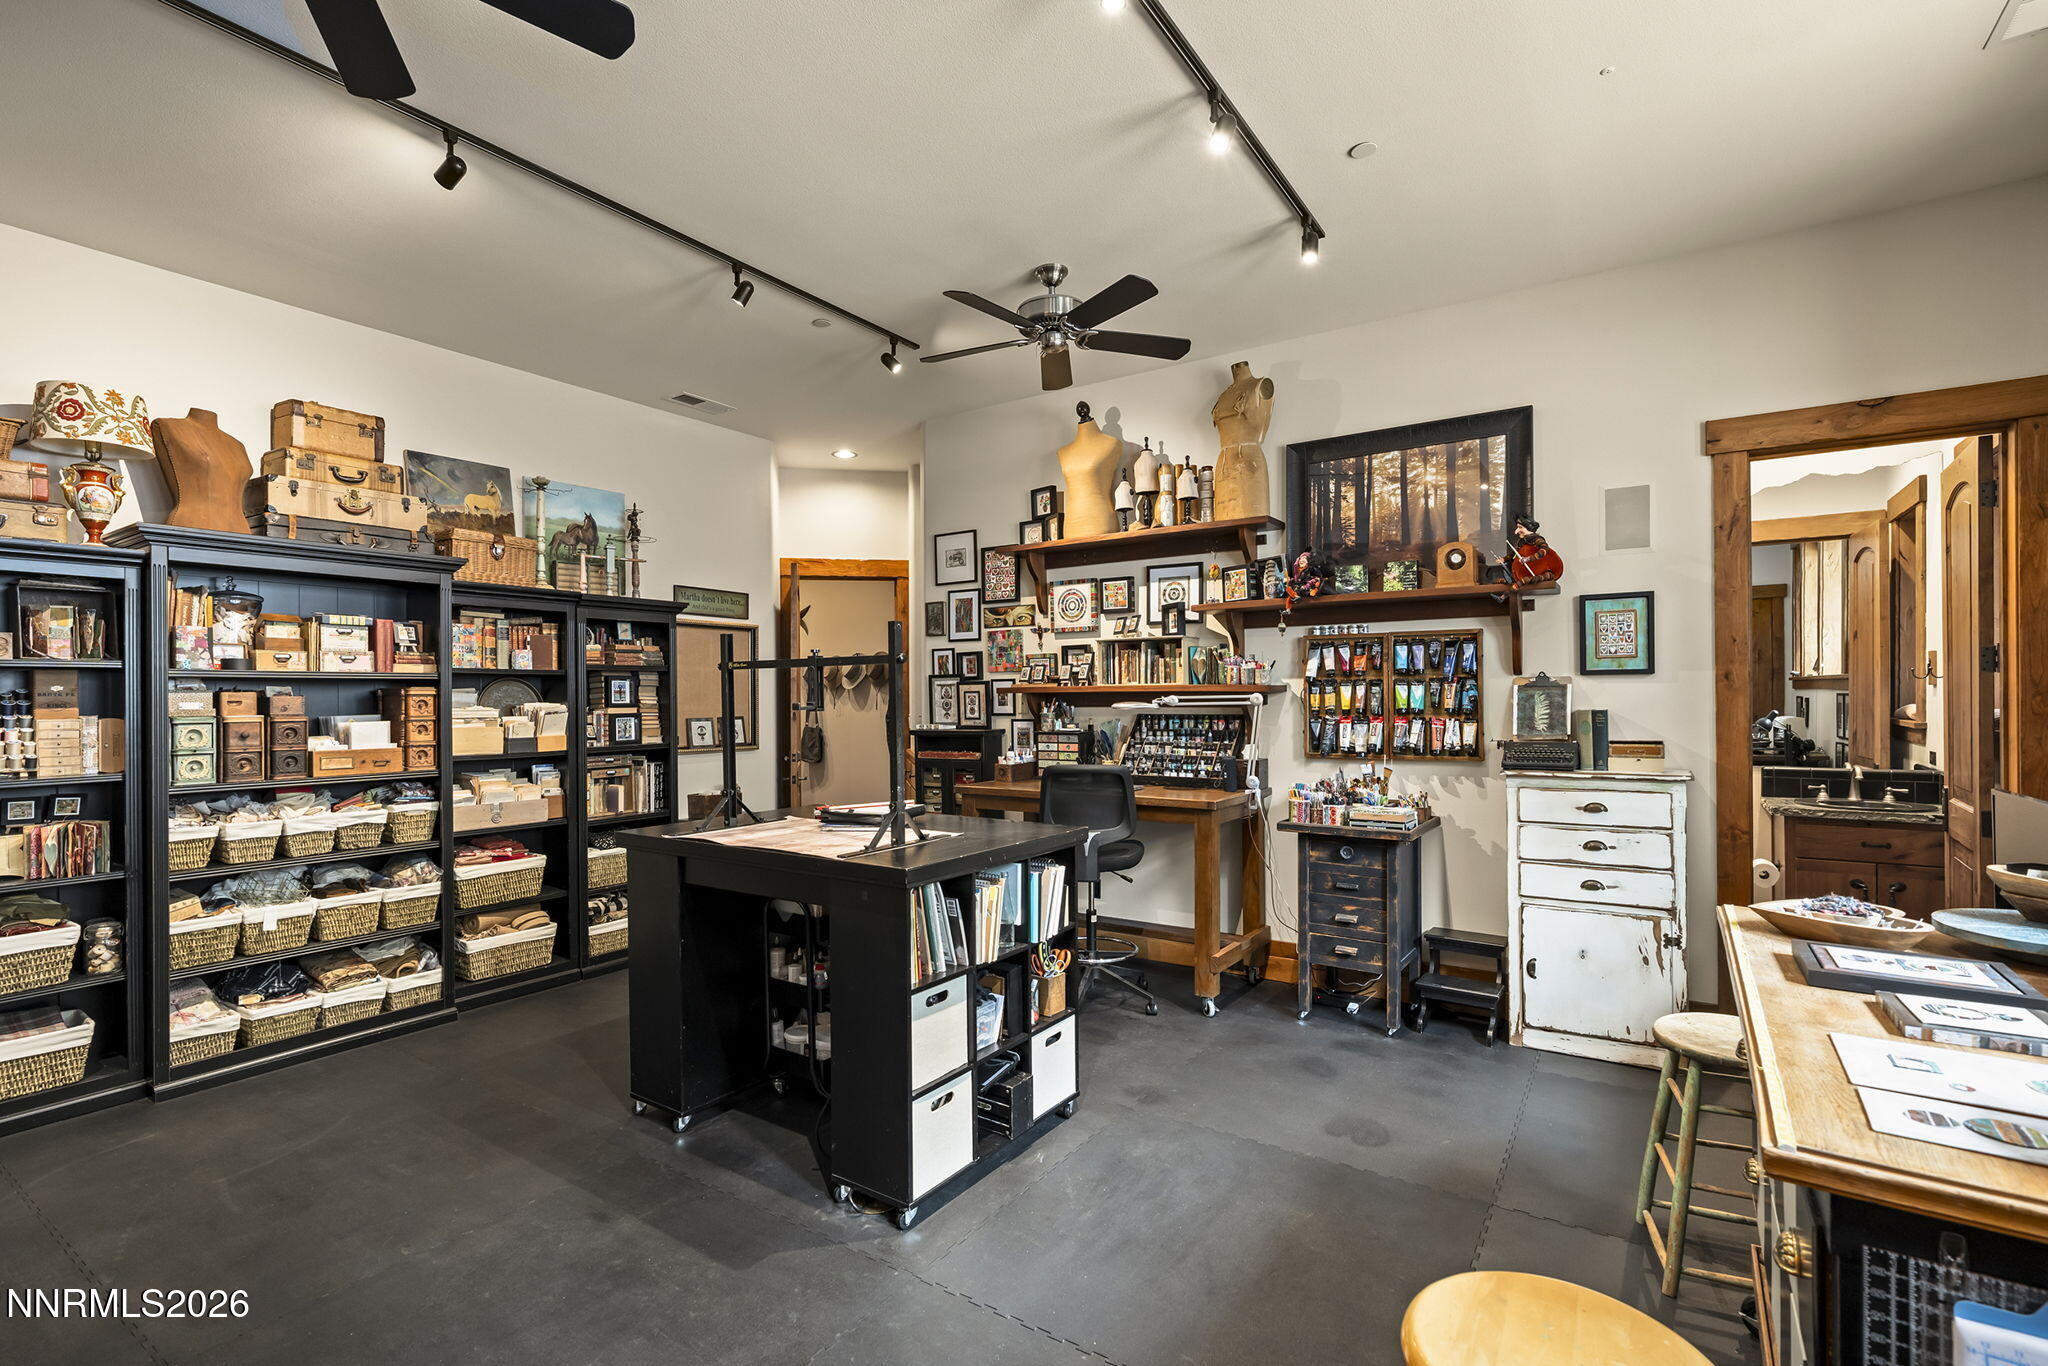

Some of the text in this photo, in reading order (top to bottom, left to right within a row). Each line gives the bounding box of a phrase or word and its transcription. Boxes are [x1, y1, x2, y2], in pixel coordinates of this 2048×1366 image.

[681, 591, 700, 602] Martha
[701, 593, 720, 604] doesn't
[721, 596, 730, 605] live
